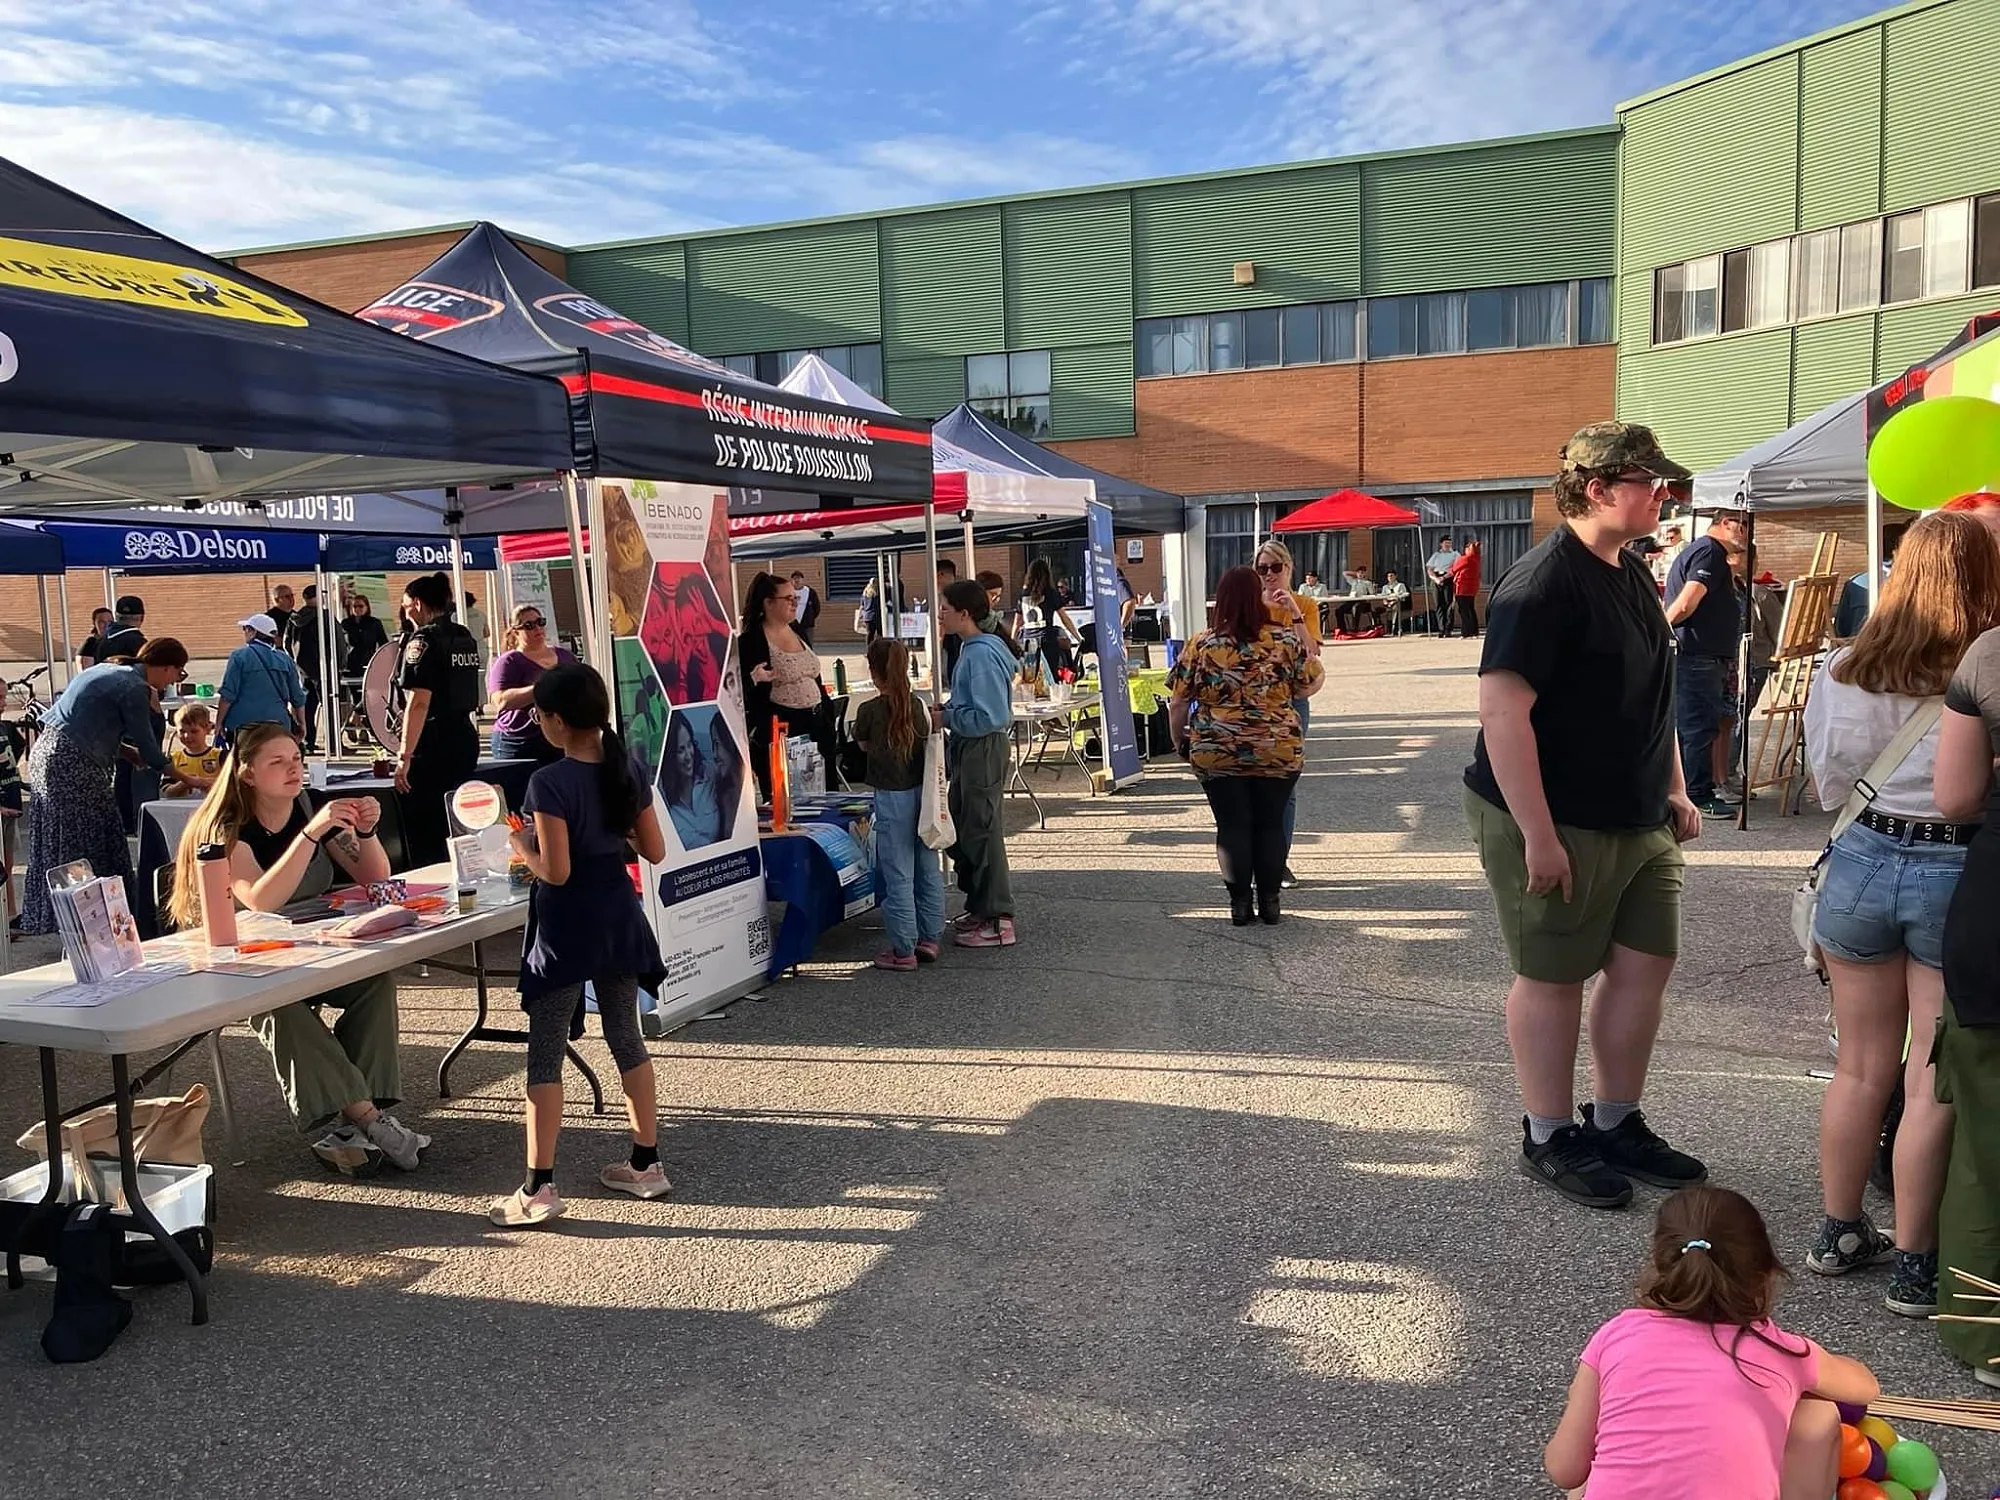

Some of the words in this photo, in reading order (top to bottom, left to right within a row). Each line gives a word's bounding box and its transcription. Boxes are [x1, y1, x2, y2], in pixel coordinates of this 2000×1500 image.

[701, 383, 755, 428] RÉGIE
[750, 399, 874, 446] INTERMUNICIPALE
[714, 433, 738, 467] DE
[739, 436, 794, 475] POLICE
[793, 444, 873, 483] ROUSSILLON
[648, 503, 703, 520] BENADO
[177, 529, 267, 560] Delson
[423, 545, 473, 564] Delsn
[451, 652, 479, 667] POLICE
[710, 874, 723, 886] NOS
